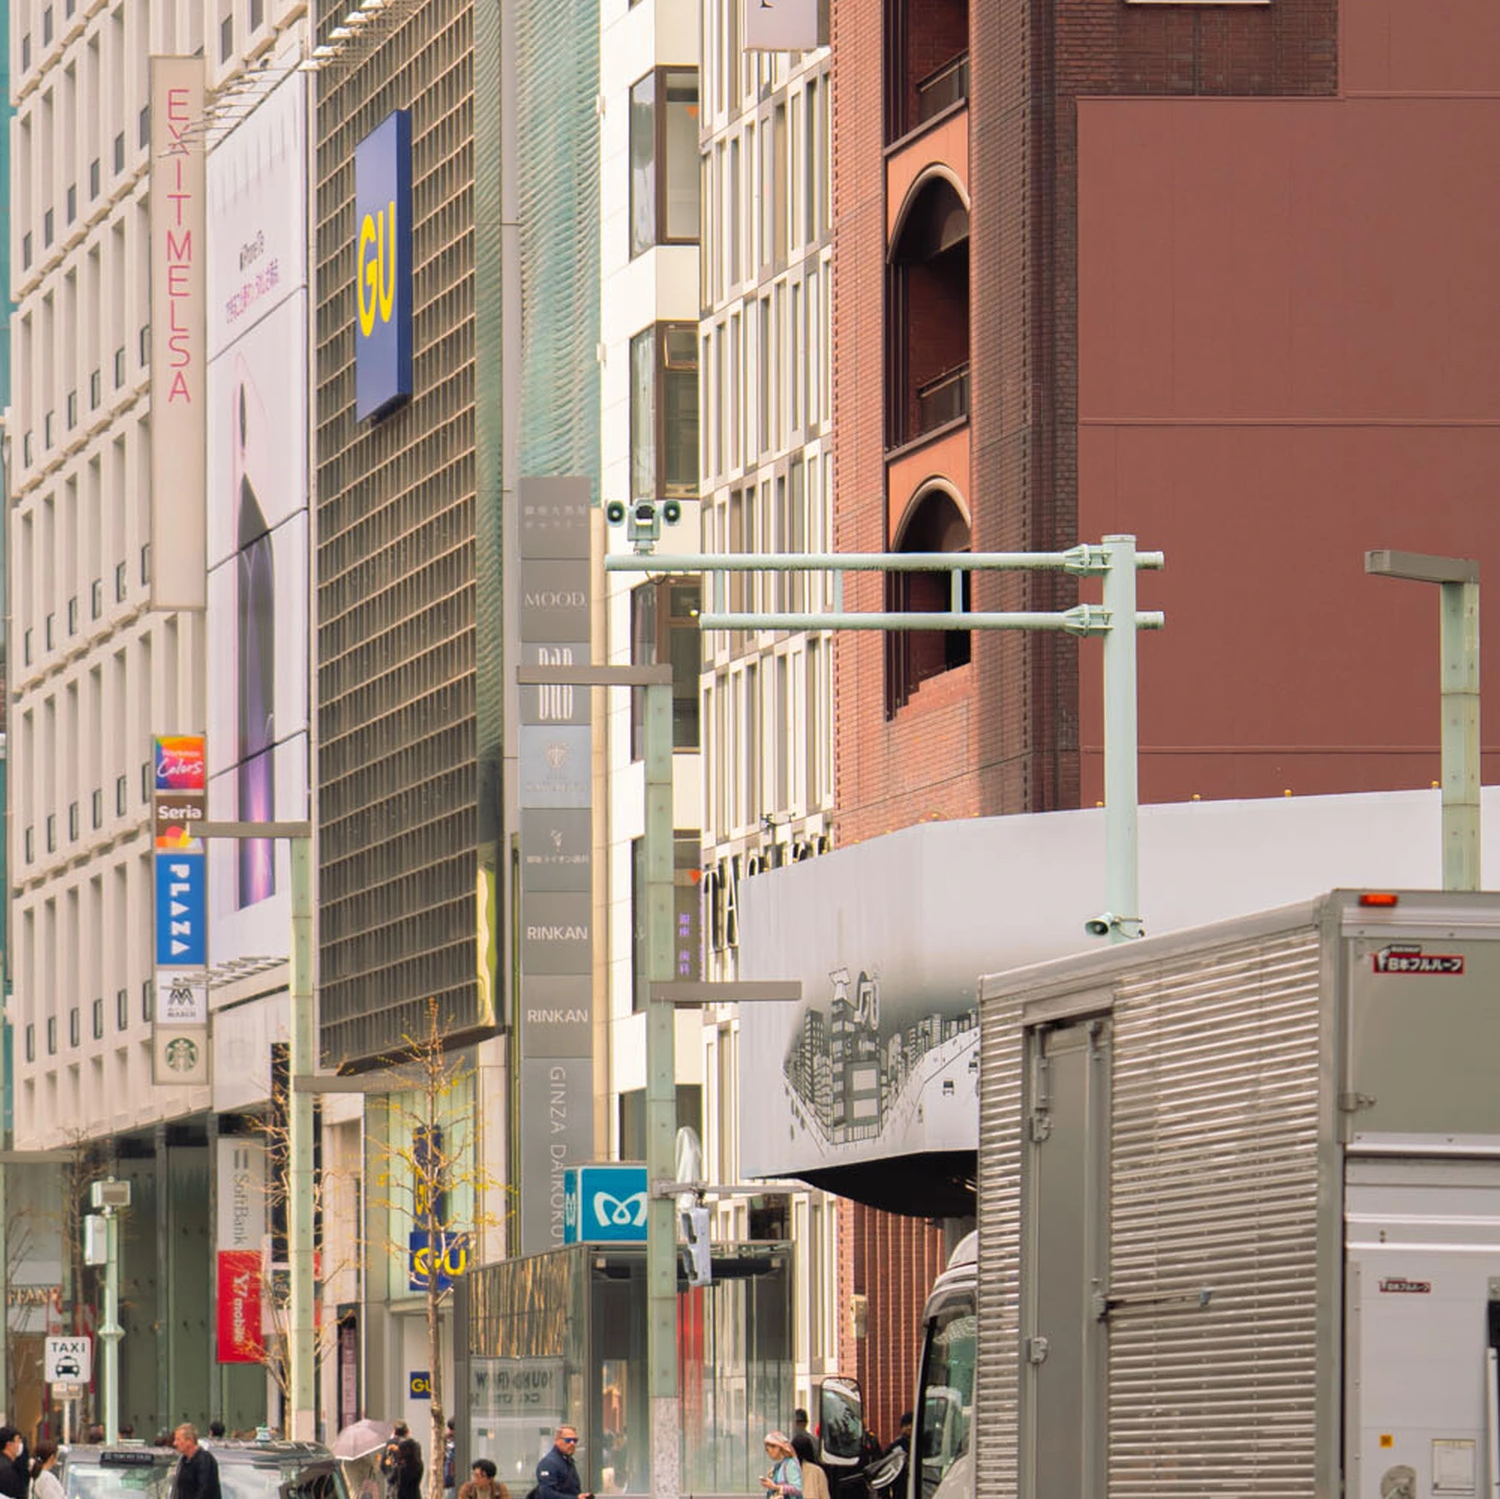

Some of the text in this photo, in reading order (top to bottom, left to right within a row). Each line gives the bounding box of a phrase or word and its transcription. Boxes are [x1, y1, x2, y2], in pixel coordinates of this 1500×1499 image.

[357, 201, 396, 337] GU
[158, 804, 203, 819] Seria
[170, 863, 192, 957] PLAZA
[527, 926, 588, 940] RINKAN
[1388, 957, 1462, 972] 日本フルハーフ
[527, 1009, 588, 1023] RINKAN
[550, 1066, 567, 1134] GINZA
[232, 1174, 250, 1246] SoftBank
[413, 1247, 466, 1276] GU
[52, 1342, 85, 1354] TAXI
